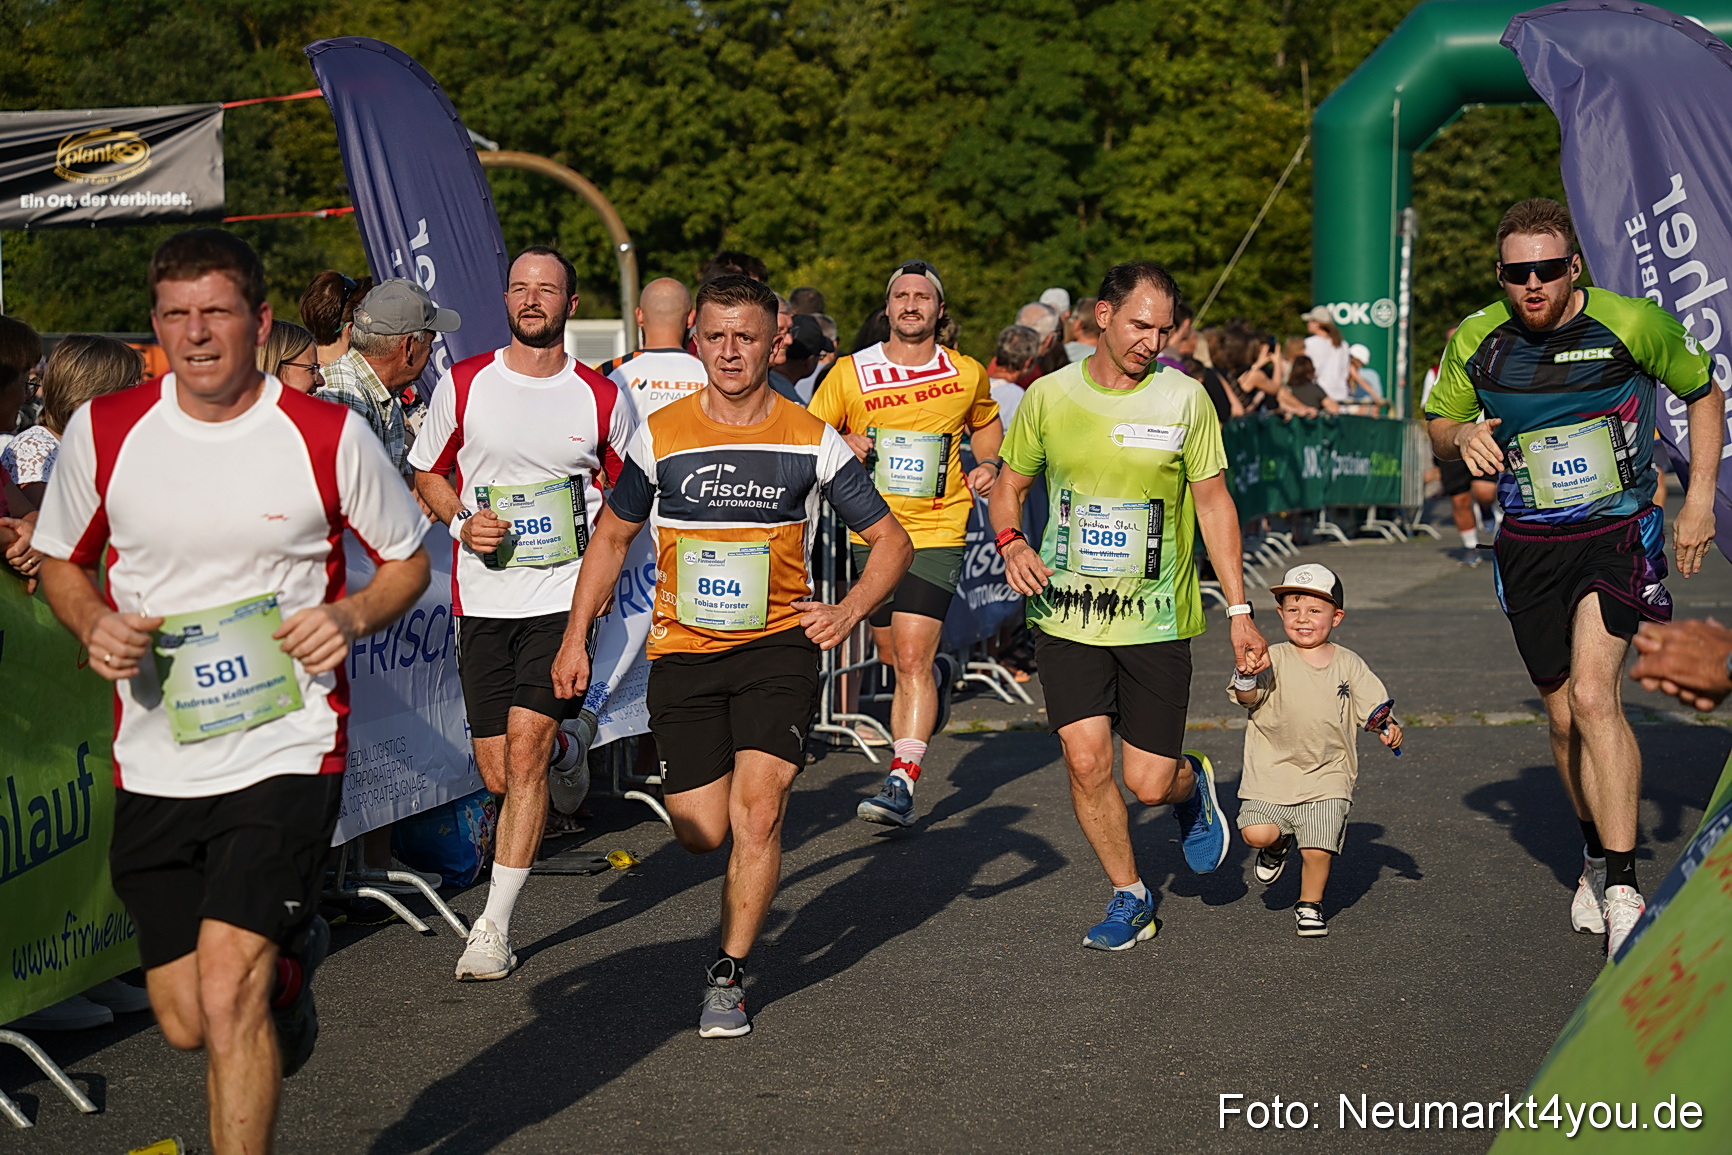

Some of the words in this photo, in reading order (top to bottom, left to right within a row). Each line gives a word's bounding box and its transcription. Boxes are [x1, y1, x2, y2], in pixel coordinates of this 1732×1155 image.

[20, 193, 45, 208] Ein
[47, 194, 78, 209] Ort,
[80, 192, 108, 207] der
[109, 191, 193, 206] verbindet.
[1553, 347, 1614, 364] BOCK
[649, 391, 687, 401] DYNA
[864, 393, 909, 412] MAX
[914, 381, 965, 403] BÖGL
[889, 456, 924, 472] 1723
[1552, 457, 1588, 477] 416
[700, 480, 786, 499] Fischer
[1552, 479, 1579, 489] Roland
[1579, 474, 1598, 485] Hönl
[707, 499, 779, 510] AUTOMOBILE
[514, 516, 552, 535] 586
[1078, 518, 1110, 529] Christian
[511, 539, 536, 547] Marcel
[537, 535, 562, 545] Kovacs
[577, 526, 585, 551] HILTL
[1081, 528, 1127, 547] 1389
[1147, 550, 1155, 573] HILTL
[698, 577, 742, 597] 864
[693, 598, 719, 609] Tobias
[719, 601, 750, 610] Forster
[194, 655, 250, 689] 581
[175, 697, 220, 710] Andreas
[223, 675, 287, 702] Kellermann
[368, 735, 406, 763] LOGISTICS
[344, 763, 392, 791] CORPORATE
[391, 755, 414, 777] PRINT
[349, 783, 394, 813] CORPORATE
[394, 772, 427, 798] SIGNAGE
